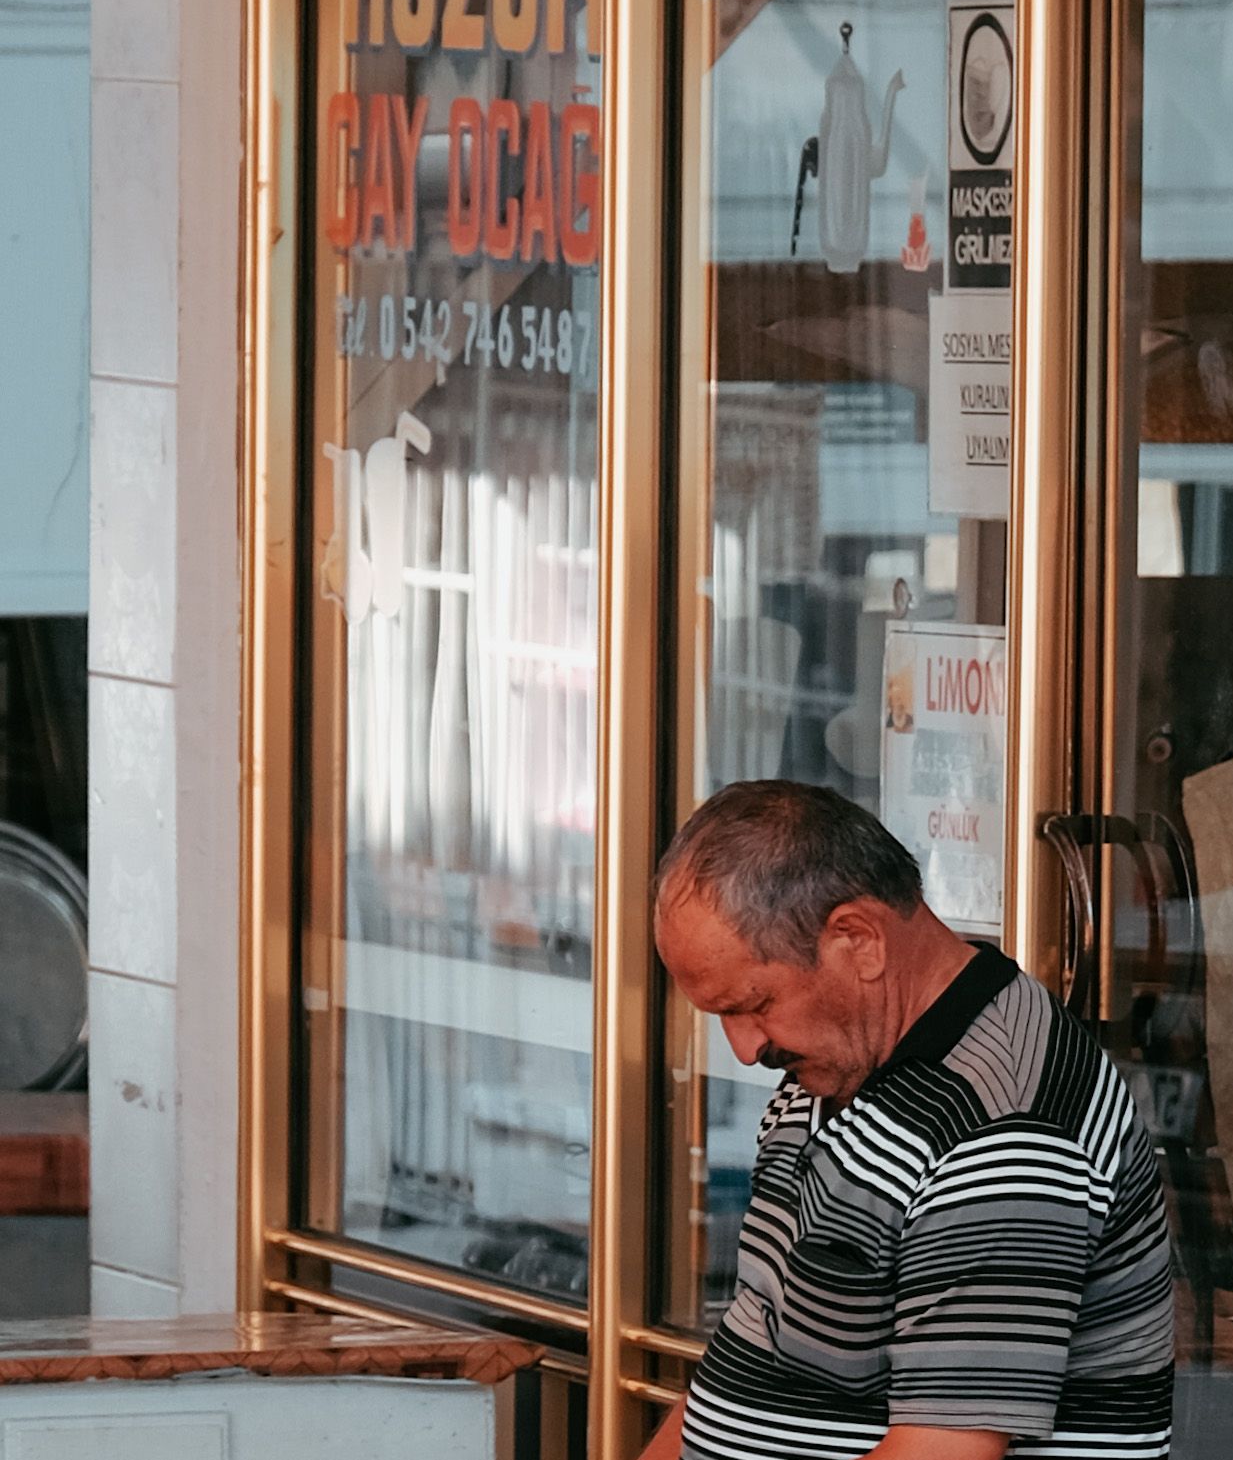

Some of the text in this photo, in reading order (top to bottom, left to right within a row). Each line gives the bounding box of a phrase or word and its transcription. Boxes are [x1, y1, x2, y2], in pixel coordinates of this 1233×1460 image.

[379, 294, 452, 365] 0542
[462, 300, 515, 370] 746
[520, 305, 593, 375] 5487
[943, 333, 986, 359] SOSYAL
[928, 803, 981, 843] GÜNLÜK
